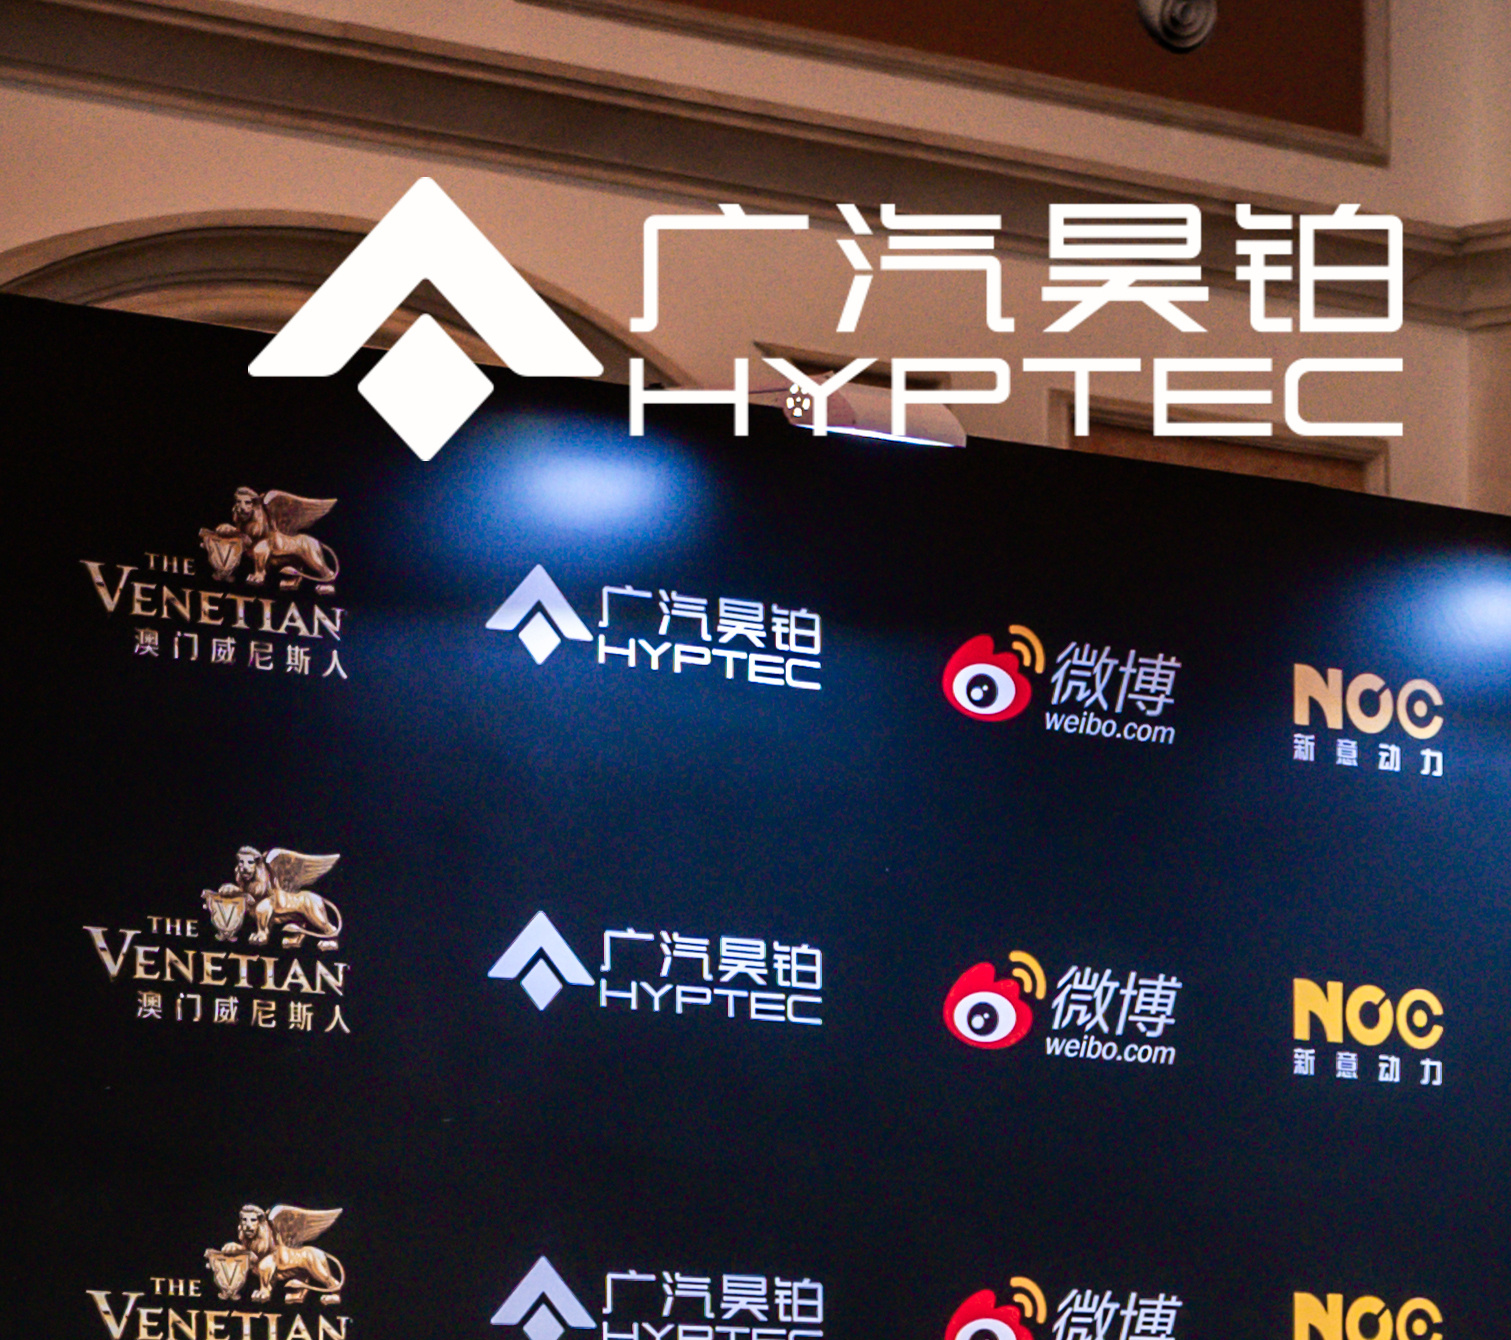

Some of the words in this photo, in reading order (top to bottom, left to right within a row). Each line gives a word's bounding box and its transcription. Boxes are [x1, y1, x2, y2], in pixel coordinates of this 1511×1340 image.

[145, 552, 196, 576] THE
[80, 560, 345, 643] VENETIAN
[597, 584, 822, 655] 广汽昊铂
[133, 628, 349, 681] 澳门威尼斯人
[596, 633, 822, 691] HYPTEC
[1050, 641, 1182, 717] 微博
[1045, 710, 1176, 744] weibo.com
[1293, 662, 1444, 740] NOC
[147, 915, 199, 938] THE
[82, 925, 348, 997] VENETIAN
[600, 927, 823, 990] 广汽昊铂
[136, 990, 351, 1034] 澳门威尼斯人
[599, 978, 823, 1025] HYPTEC
[1051, 965, 1183, 1038] 微博
[1292, 977, 1444, 1050] NOC
[1045, 1034, 1176, 1065] weibo.com
[150, 1276, 202, 1298] THE
[601, 1269, 824, 1324] 广汽昊铂
